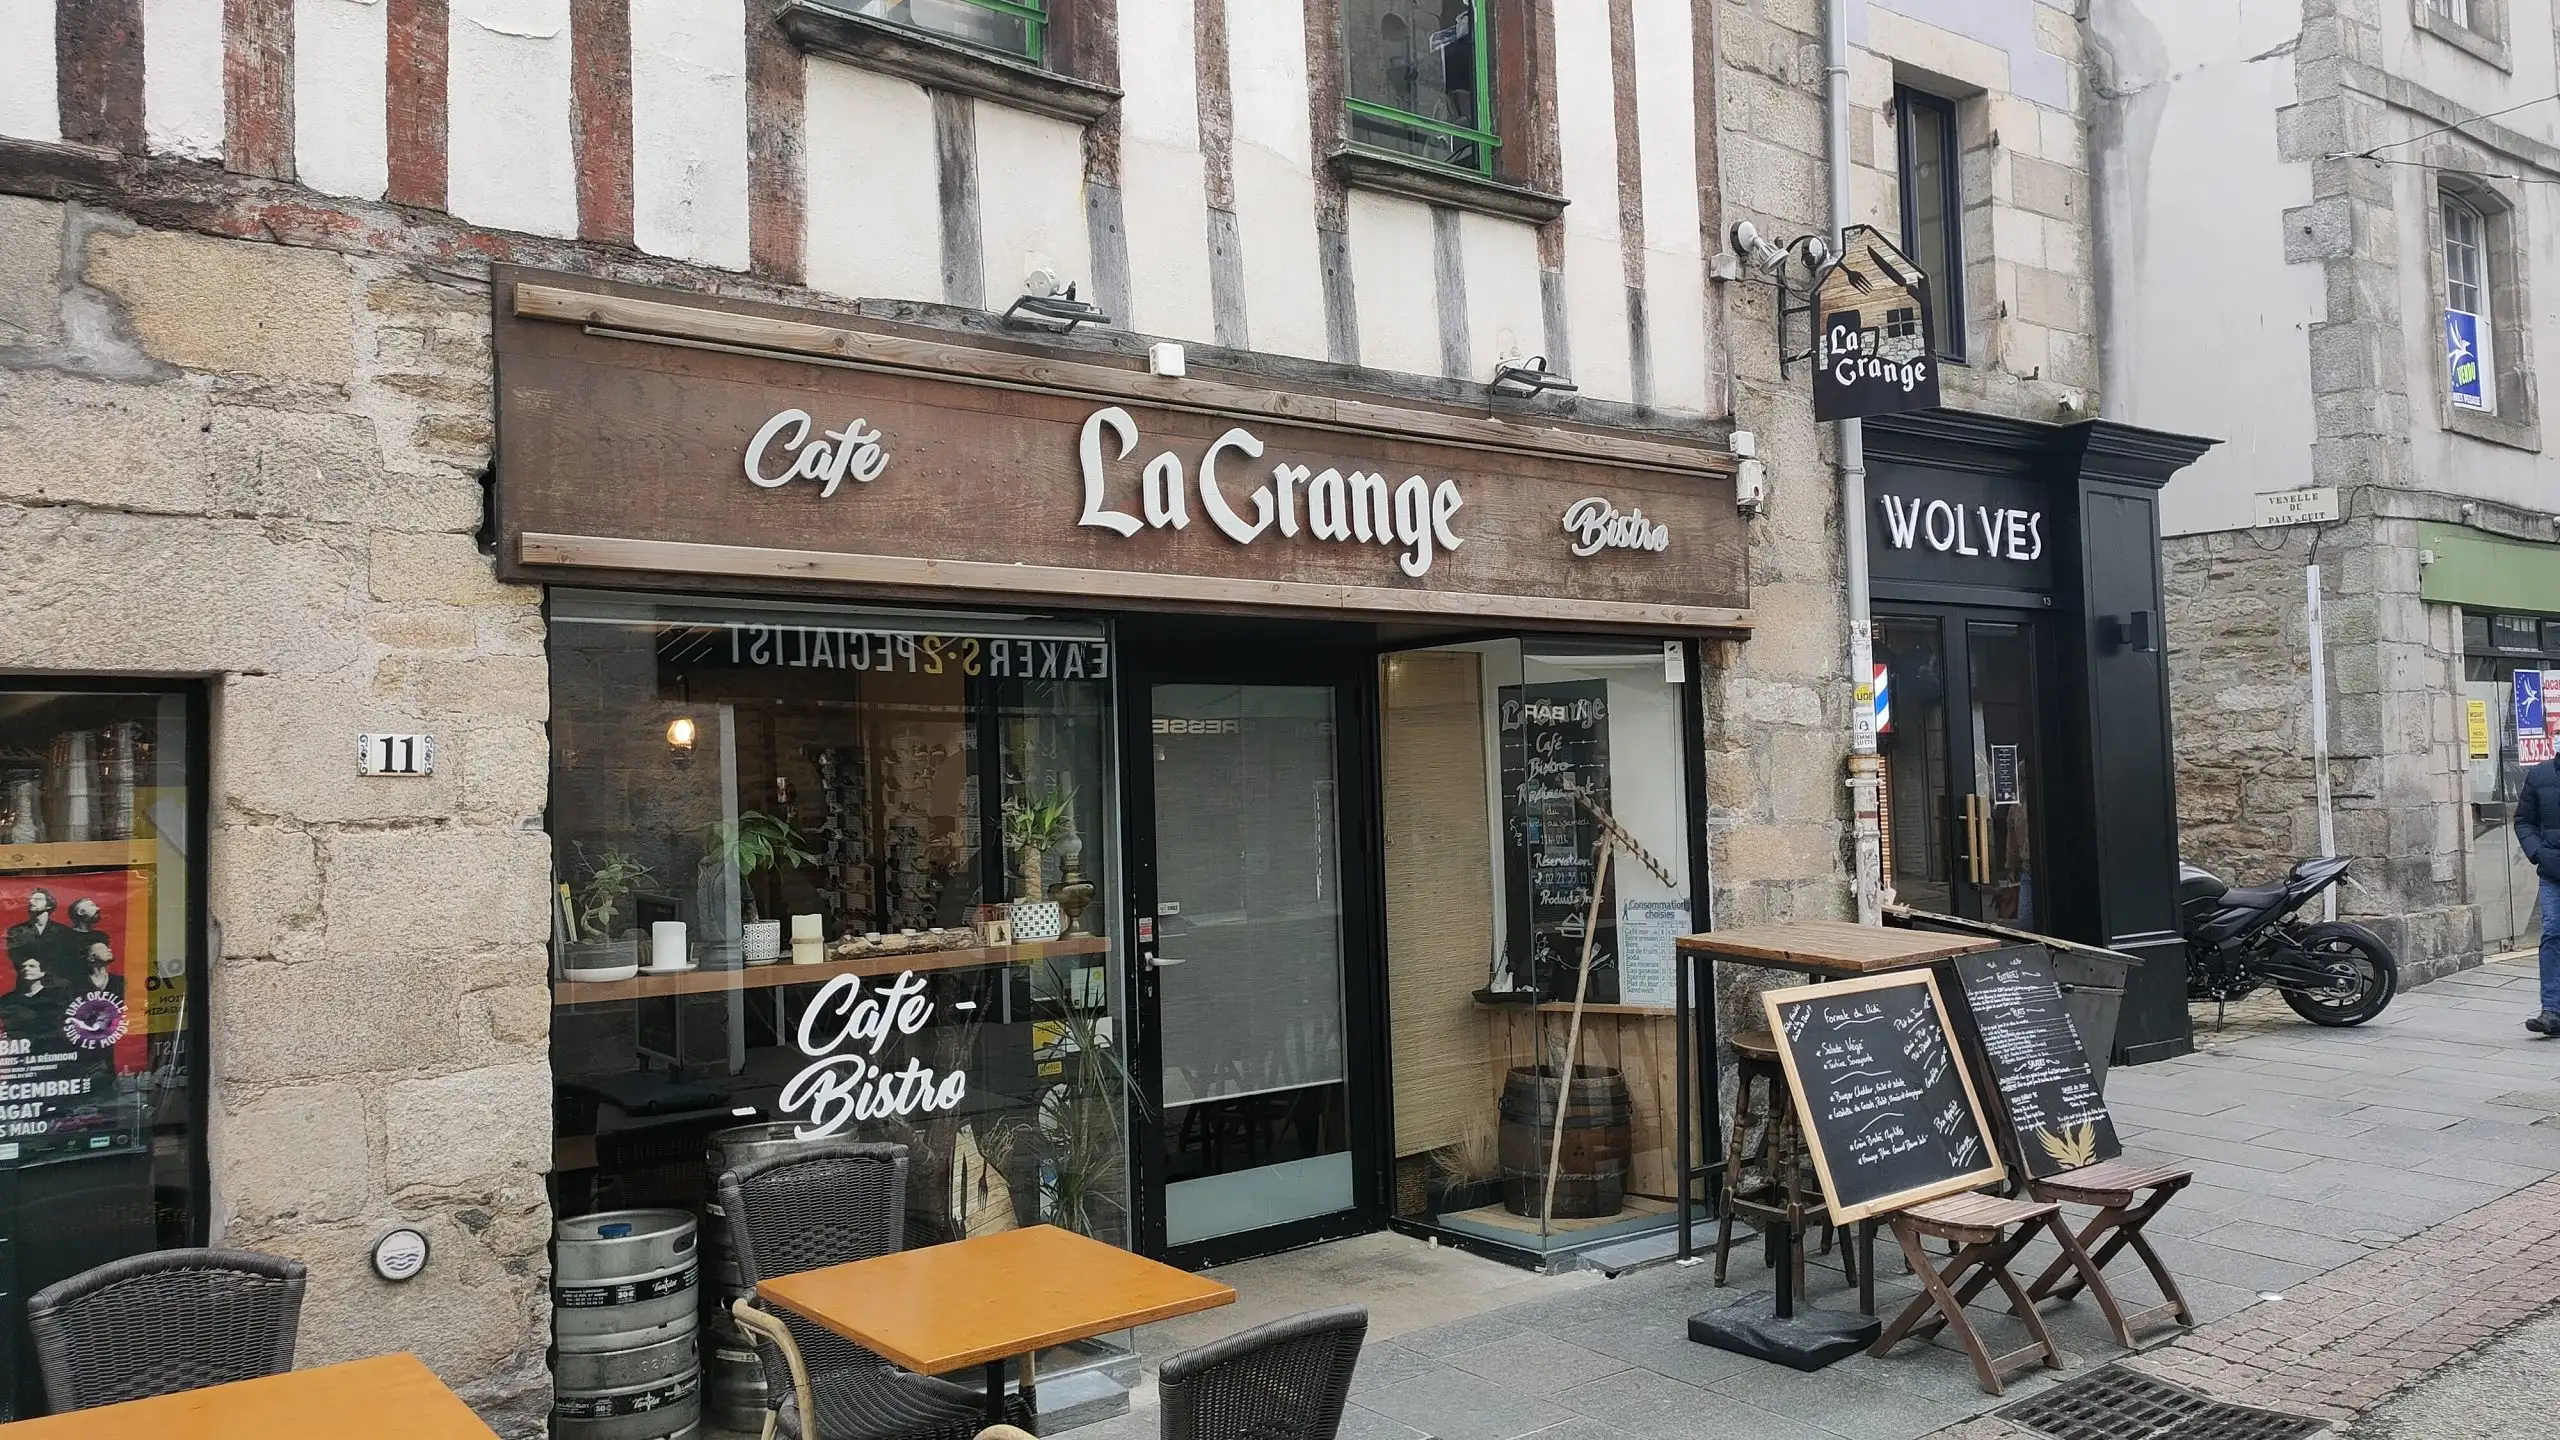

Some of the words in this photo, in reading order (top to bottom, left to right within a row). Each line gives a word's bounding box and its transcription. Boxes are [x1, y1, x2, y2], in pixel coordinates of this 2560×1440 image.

[1830, 324, 1861, 355] La
[1835, 356, 1927, 392] Grange
[745, 408, 890, 498] Café
[1077, 406, 1191, 538] La
[1199, 427, 1464, 578] Grange
[2268, 492, 2319, 505] VENELLE
[2289, 503, 2303, 511] DU
[1562, 496, 1669, 556] Bistro
[1882, 494, 2042, 561] WOLVES
[2043, 597, 2051, 606] 13
[379, 735, 418, 773] 11
[1535, 732, 1563, 757] Café
[1528, 756, 1575, 781] Bistro
[1540, 889, 1580, 905] Produits
[1628, 900, 1686, 911] Consommation
[1645, 911, 1675, 919] choisies
[66, 996, 86, 1016] UNE
[86, 990, 129, 1013] OREILLE
[797, 969, 934, 1056] Café
[64, 1024, 80, 1045] SUR
[82, 1038, 96, 1050] LE
[100, 1019, 130, 1048] MONDE
[778, 1054, 965, 1141] Bistro
[10, 1121, 47, 1137] MALO
